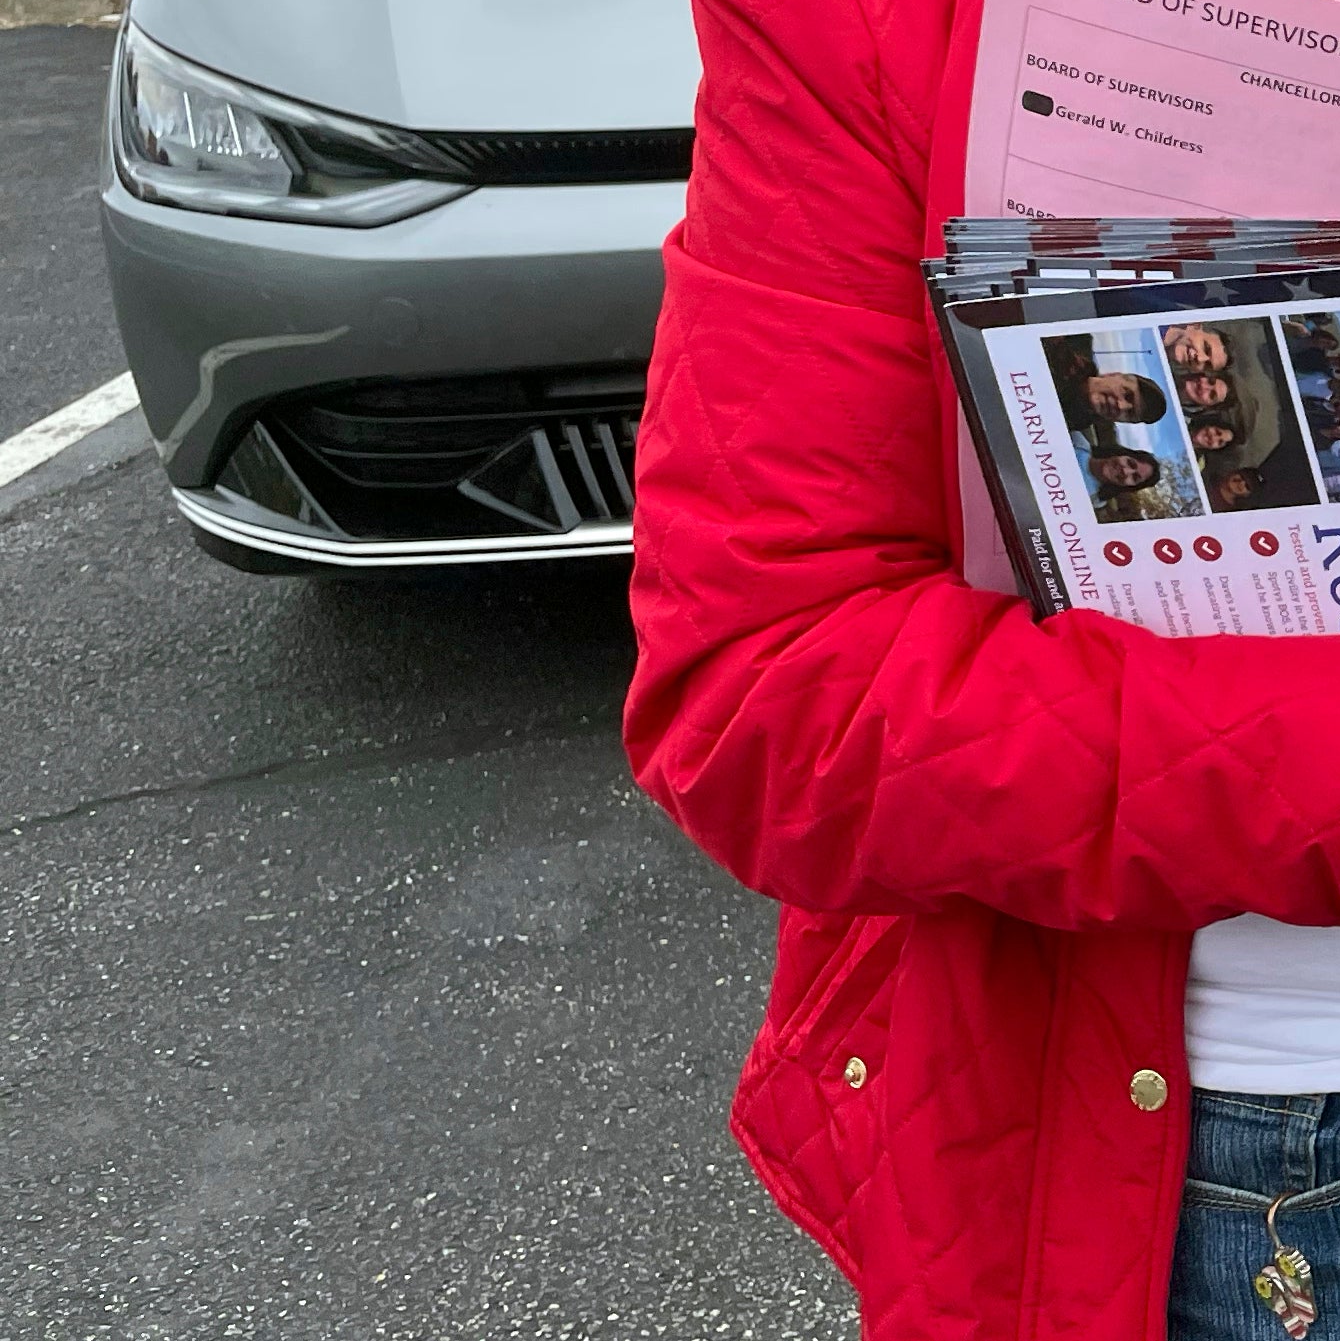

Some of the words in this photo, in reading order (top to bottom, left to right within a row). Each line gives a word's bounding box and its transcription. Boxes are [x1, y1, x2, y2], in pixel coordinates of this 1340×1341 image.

[1026, 54, 1080, 79] BOARD
[1084, 71, 1105, 86] OF
[1108, 78, 1214, 116] SUPERVISORS
[1055, 105, 1105, 129] Gerald
[1109, 119, 1130, 136] W.
[1134, 127, 1204, 154] Childress
[1009, 371, 1048, 445] LEARN
[1035, 452, 1072, 516] MORE
[1060, 522, 1100, 600] ONLINE
[1028, 528, 1047, 556] Paid
[1038, 556, 1052, 580] for
[1046, 577, 1064, 601] and
[1288, 524, 1309, 563] Tested
[1300, 563, 1317, 588] and
[1305, 590, 1326, 633] proven
